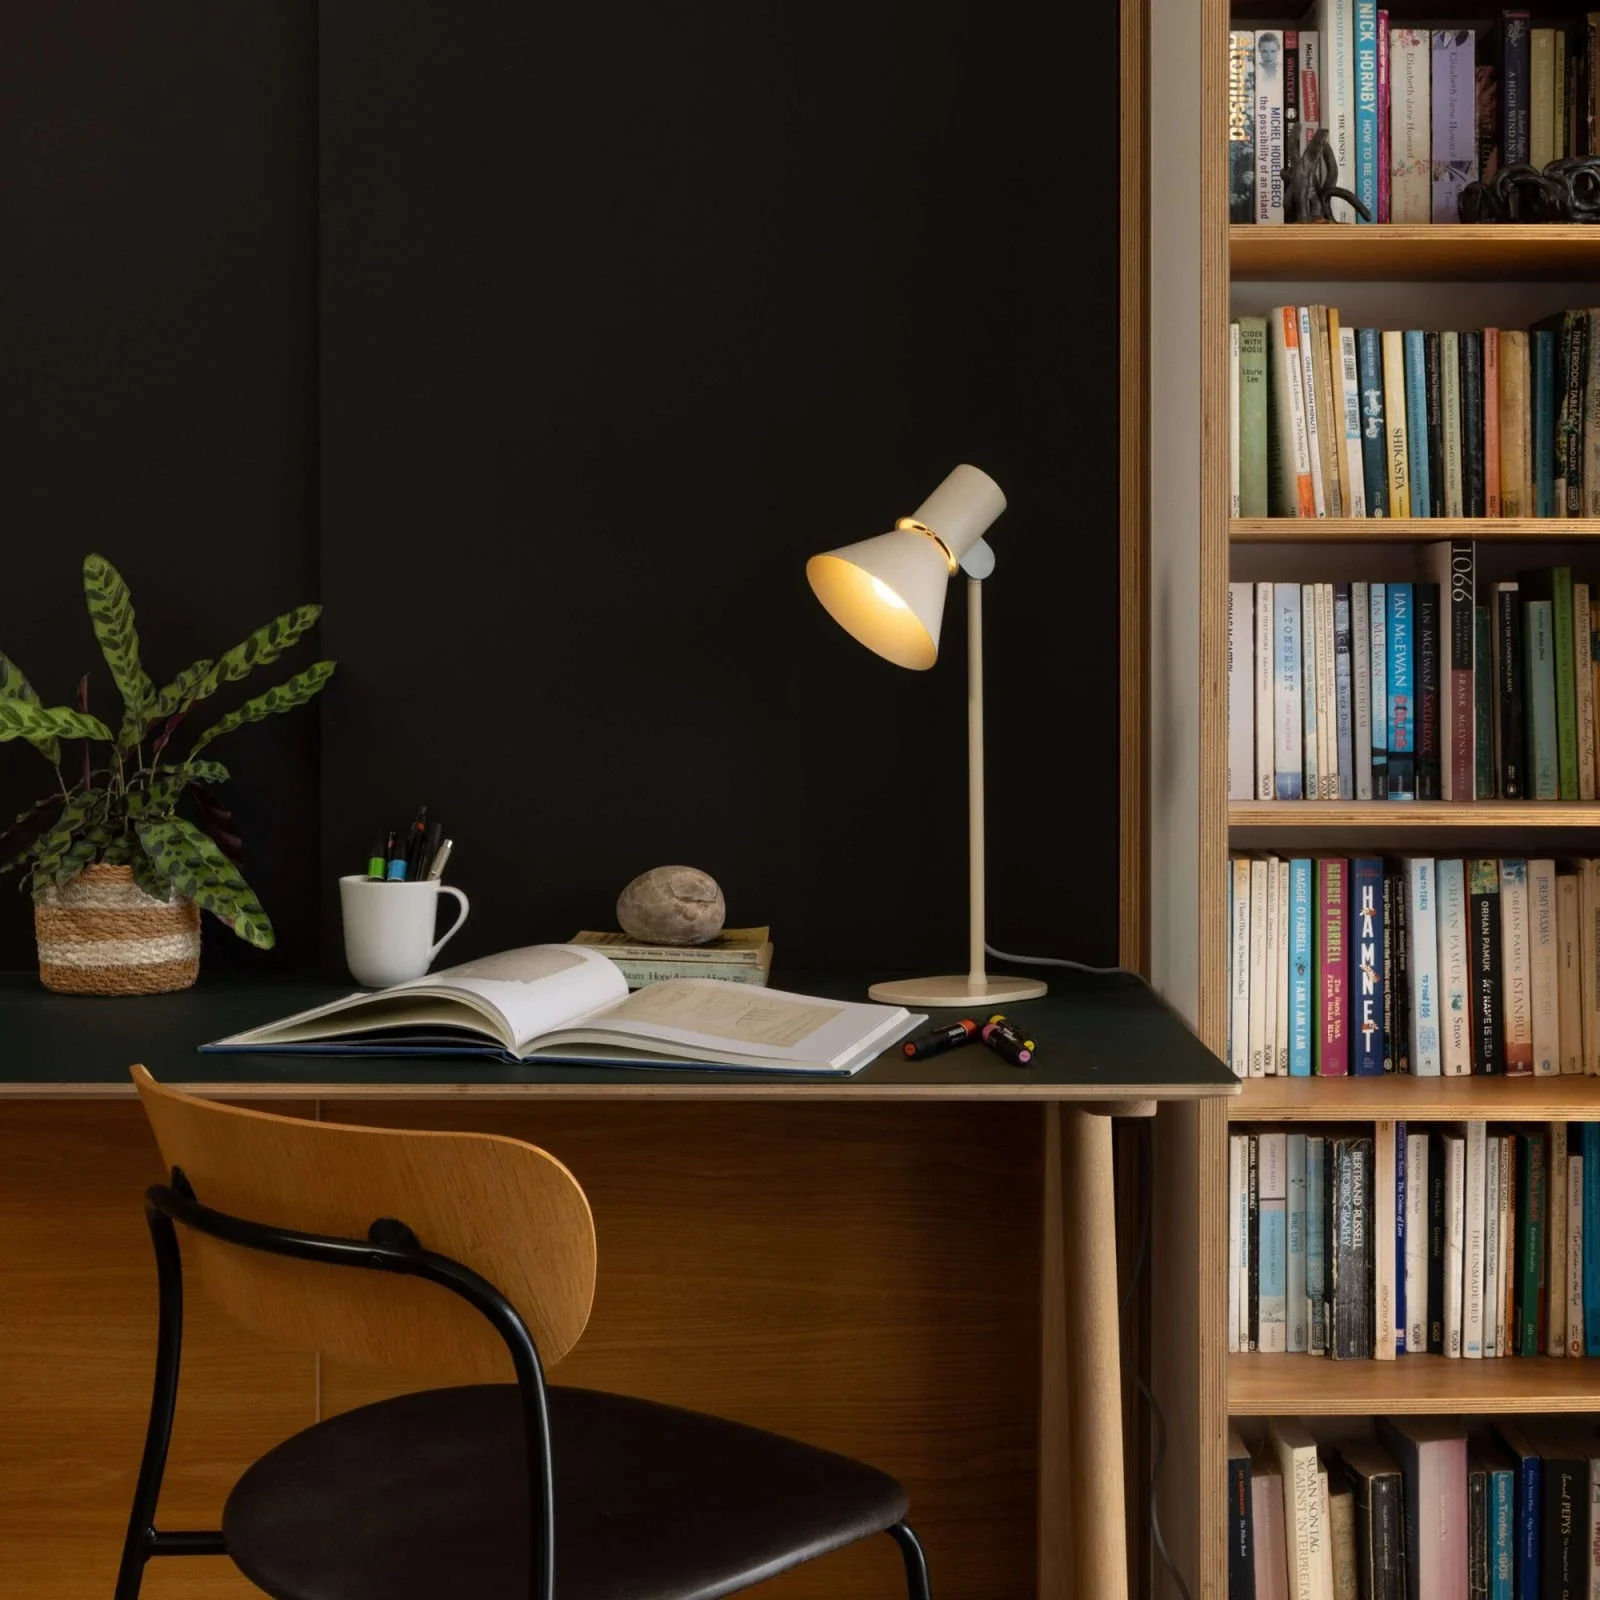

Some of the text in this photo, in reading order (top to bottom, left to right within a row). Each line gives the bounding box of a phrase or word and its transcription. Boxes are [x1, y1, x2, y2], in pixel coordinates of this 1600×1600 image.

[1287, 57, 1295, 104] WHATEVER
[1305, 43, 1314, 70] Michel
[1359, 3, 1375, 113] NICK HORNBY
[1405, 52, 1416, 159] Elizabeth Jane Howard
[1447, 52, 1459, 158] Elizabeth Jane Howard
[1508, 80, 1516, 107] HIGH
[1508, 109, 1516, 137] WIND
[1257, 96, 1270, 220] the possibility of an island
[1270, 107, 1282, 209] MICHEL HOUELLEBECQ
[1363, 120, 1372, 209] HOW TO BE GOOD
[1508, 139, 1516, 151] IN
[1306, 375, 1314, 403] HUMAN
[1569, 330, 1581, 414] THE PERIODIC TABLE
[1309, 405, 1317, 434] MINUTE
[1569, 434, 1577, 471] PRIMO LEVI
[1393, 428, 1405, 490] SHIKASTA
[1451, 546, 1473, 603] 1066
[1284, 607, 1294, 692] ATONEMENT
[1394, 593, 1407, 687] IAN McEWAN
[1458, 672, 1467, 706] FRANK
[1295, 868, 1307, 953] MAGGIE O'FARRELL
[1326, 864, 1342, 964] MAGGIE O'FARRELL
[1448, 876, 1461, 984] ORHAN PAMUK
[1482, 901, 1491, 971] ORHAN PAMUK
[1511, 891, 1521, 972] ORHAN PAMUK
[1536, 876, 1550, 945] JEREMY PAXMAN
[1334, 979, 1342, 993] The
[1360, 885, 1376, 1053] HAMNET
[1327, 974, 1335, 1044] First Held Mine
[1454, 1016, 1464, 1049] Snow
[1484, 1026, 1492, 1036] IS
[1513, 977, 1525, 1042] ISTANBUL
[1341, 1155, 1352, 1246] AUTOBIOGRAPHY
[1353, 1151, 1364, 1249] BERTRAND RUSSELL
[1397, 1181, 1405, 1193] The
[1397, 1194, 1405, 1216] Crimes
[1397, 1223, 1405, 1237] Love
[1471, 1229, 1480, 1324] THE UNMADE BED
[1295, 1459, 1311, 1600] AGAINST INTERPRETA
[1306, 1456, 1320, 1553] SUSAN SONTAG
[1496, 1473, 1509, 1581] Leon Trotsky 1905
[1561, 1501, 1572, 1535] PEPYS
